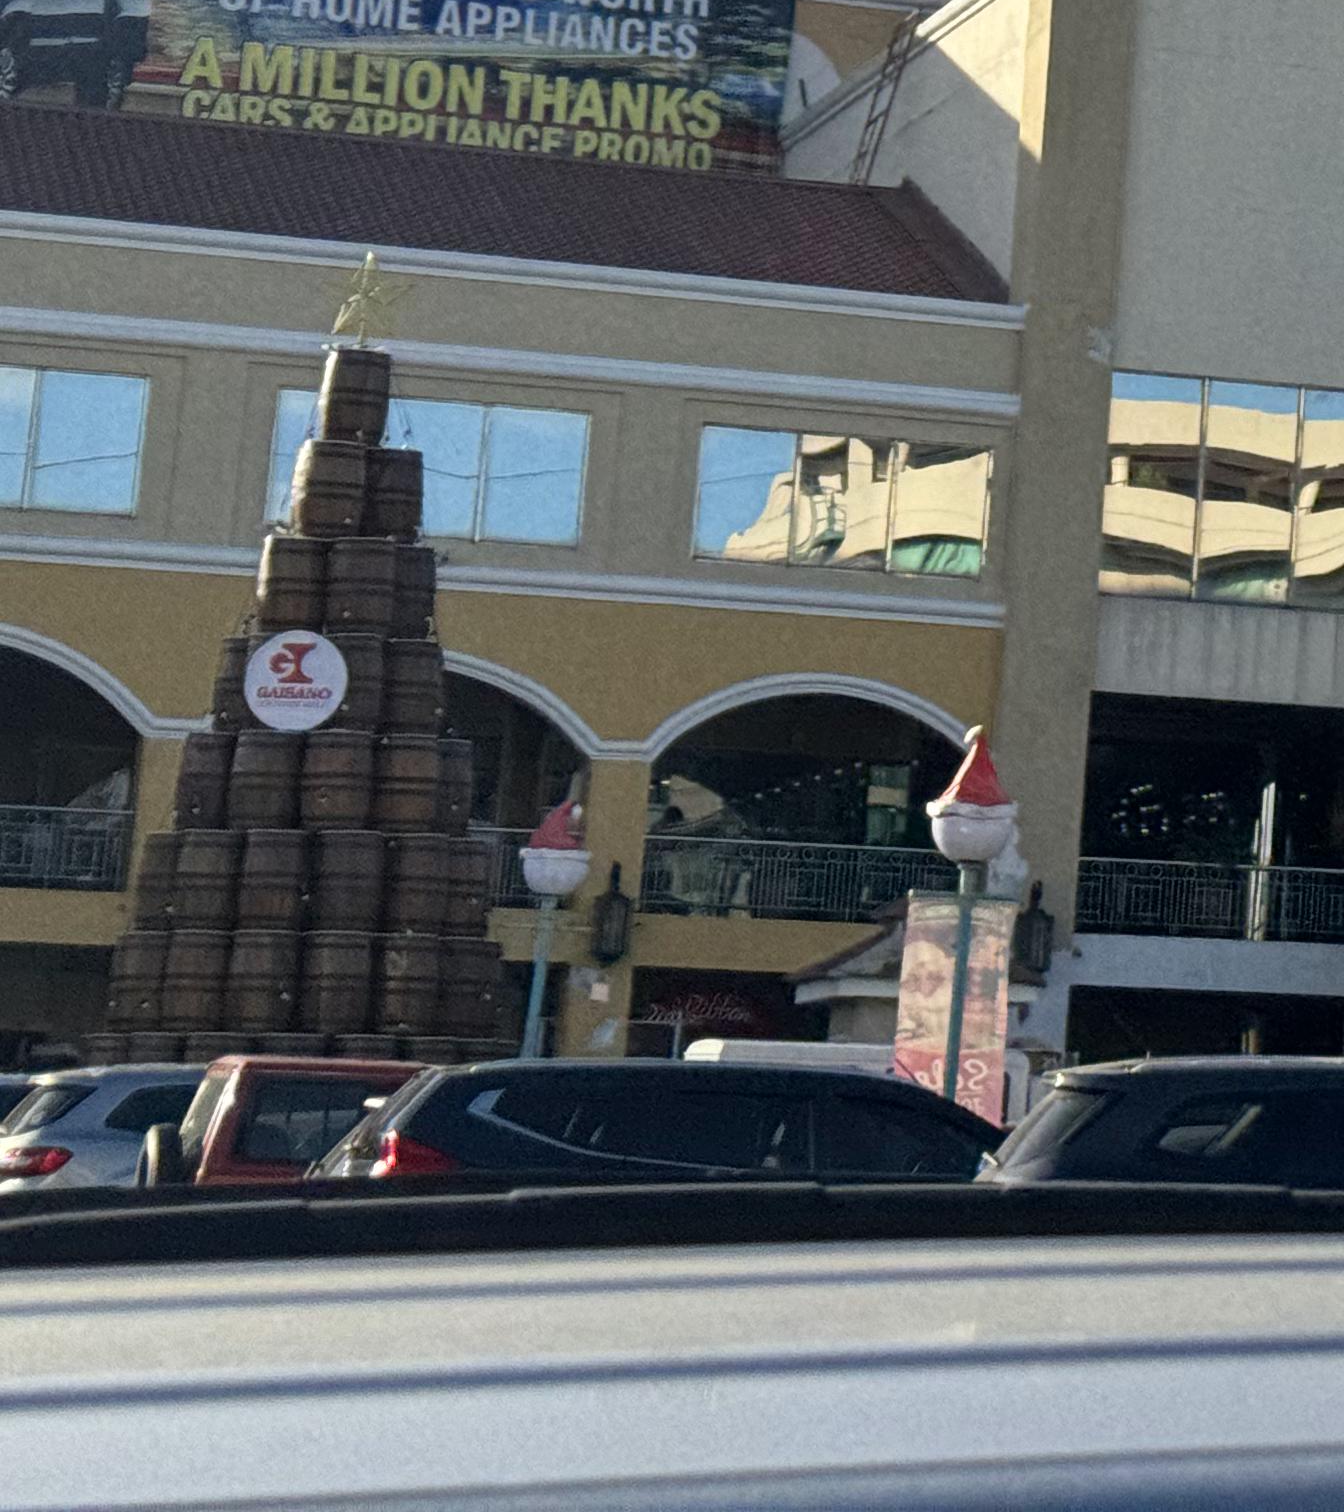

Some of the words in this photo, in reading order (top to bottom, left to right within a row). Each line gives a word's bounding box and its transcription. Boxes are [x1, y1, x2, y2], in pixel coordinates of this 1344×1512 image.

[435, 0, 700, 61] APPLIANCES
[179, 37, 223, 89] A
[239, 41, 485, 115] MILLION
[500, 69, 721, 138] THANKS
[181, 89, 293, 127] CARS
[303, 102, 335, 131] &
[573, 130, 712, 170] PROMO
